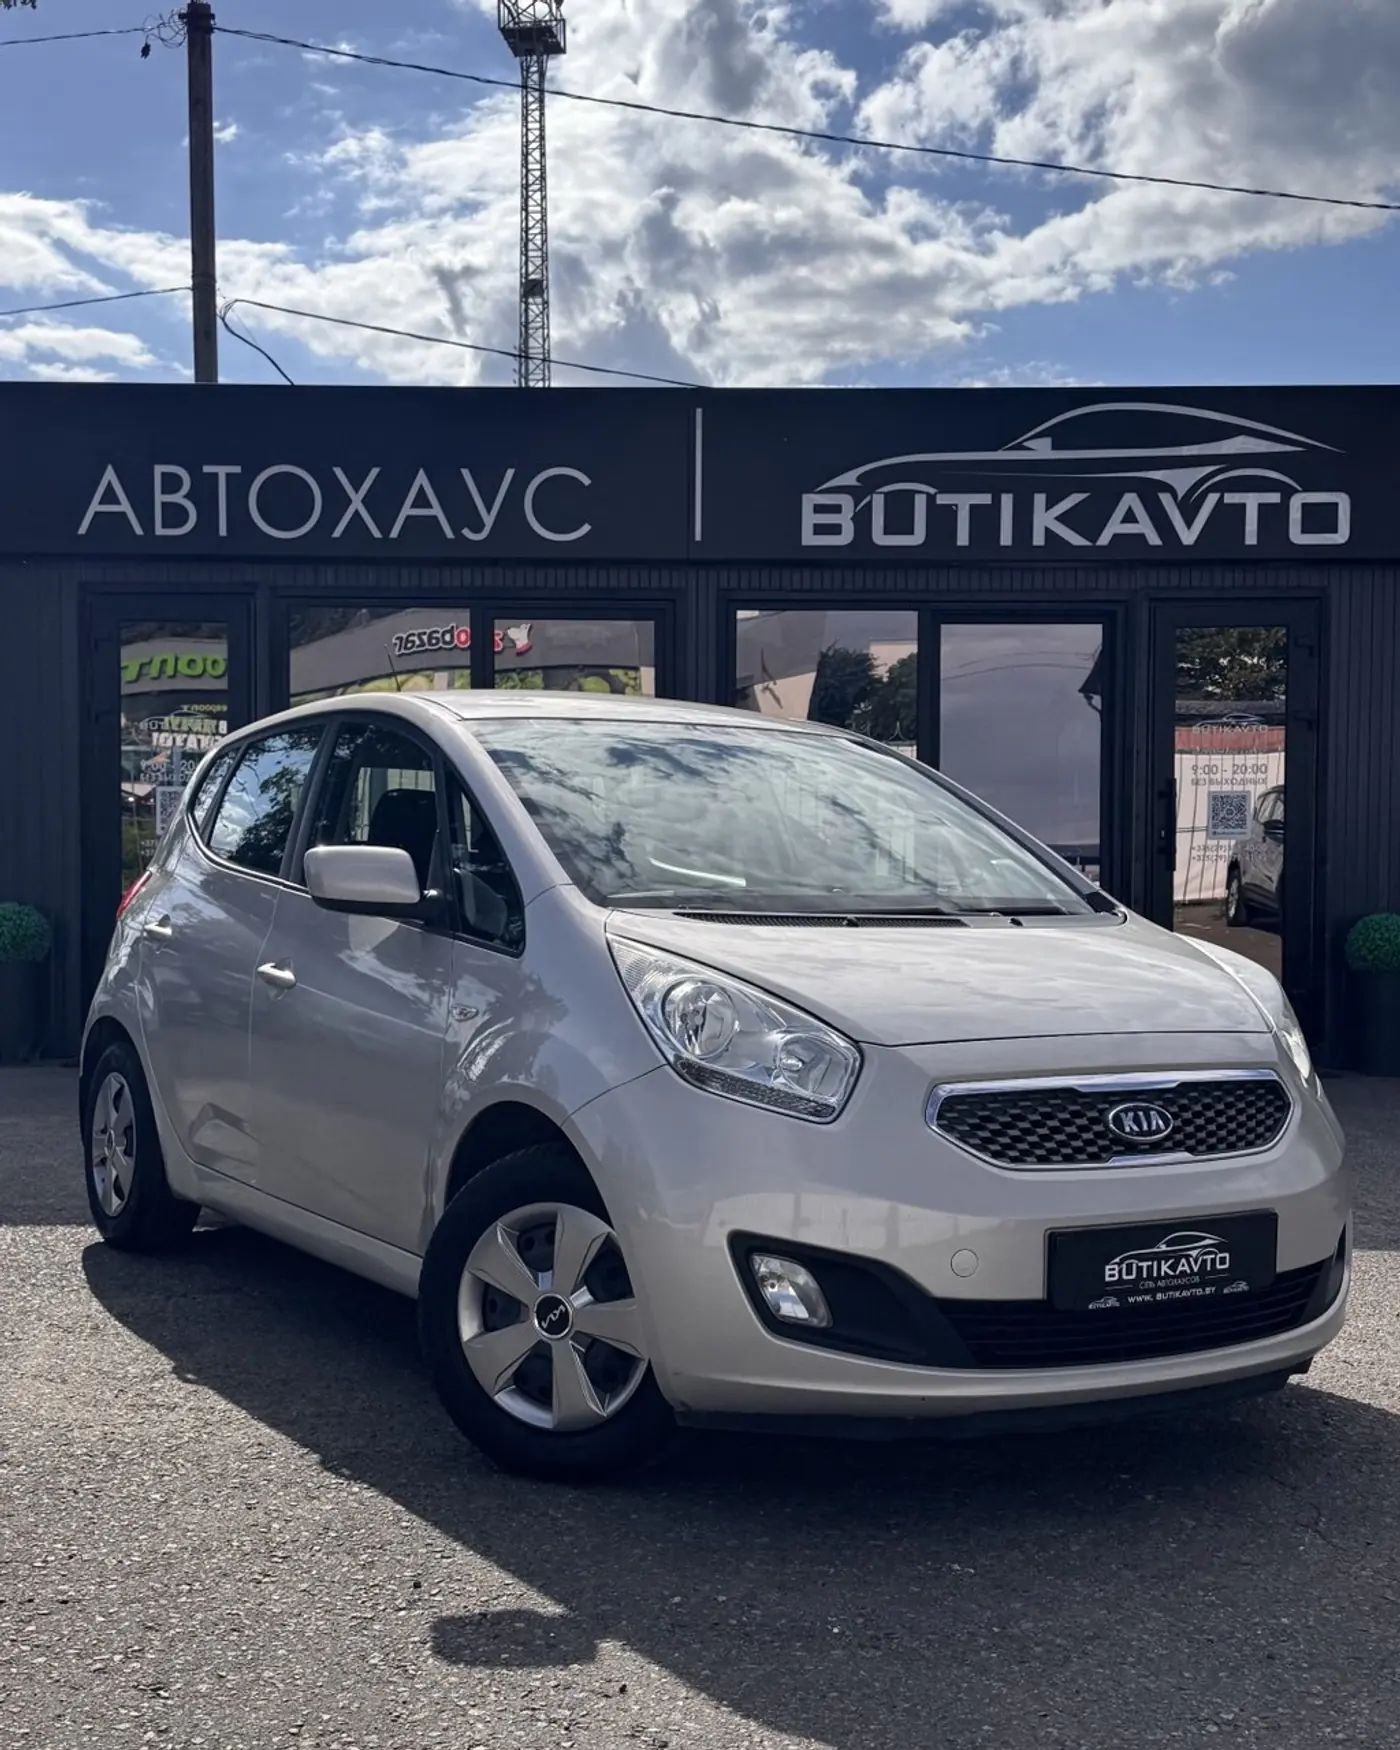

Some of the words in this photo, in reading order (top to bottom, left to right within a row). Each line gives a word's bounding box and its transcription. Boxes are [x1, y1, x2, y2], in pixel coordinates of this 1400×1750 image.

[78, 463, 593, 542] АВТОХАУС
[801, 490, 1351, 548] BUTIKAVTO
[1191, 763, 1219, 776] 9:00
[1232, 763, 1268, 776] 20:00
[1120, 1111, 1166, 1134] KIA
[1104, 1252, 1230, 1282] BUTIKAVTO
